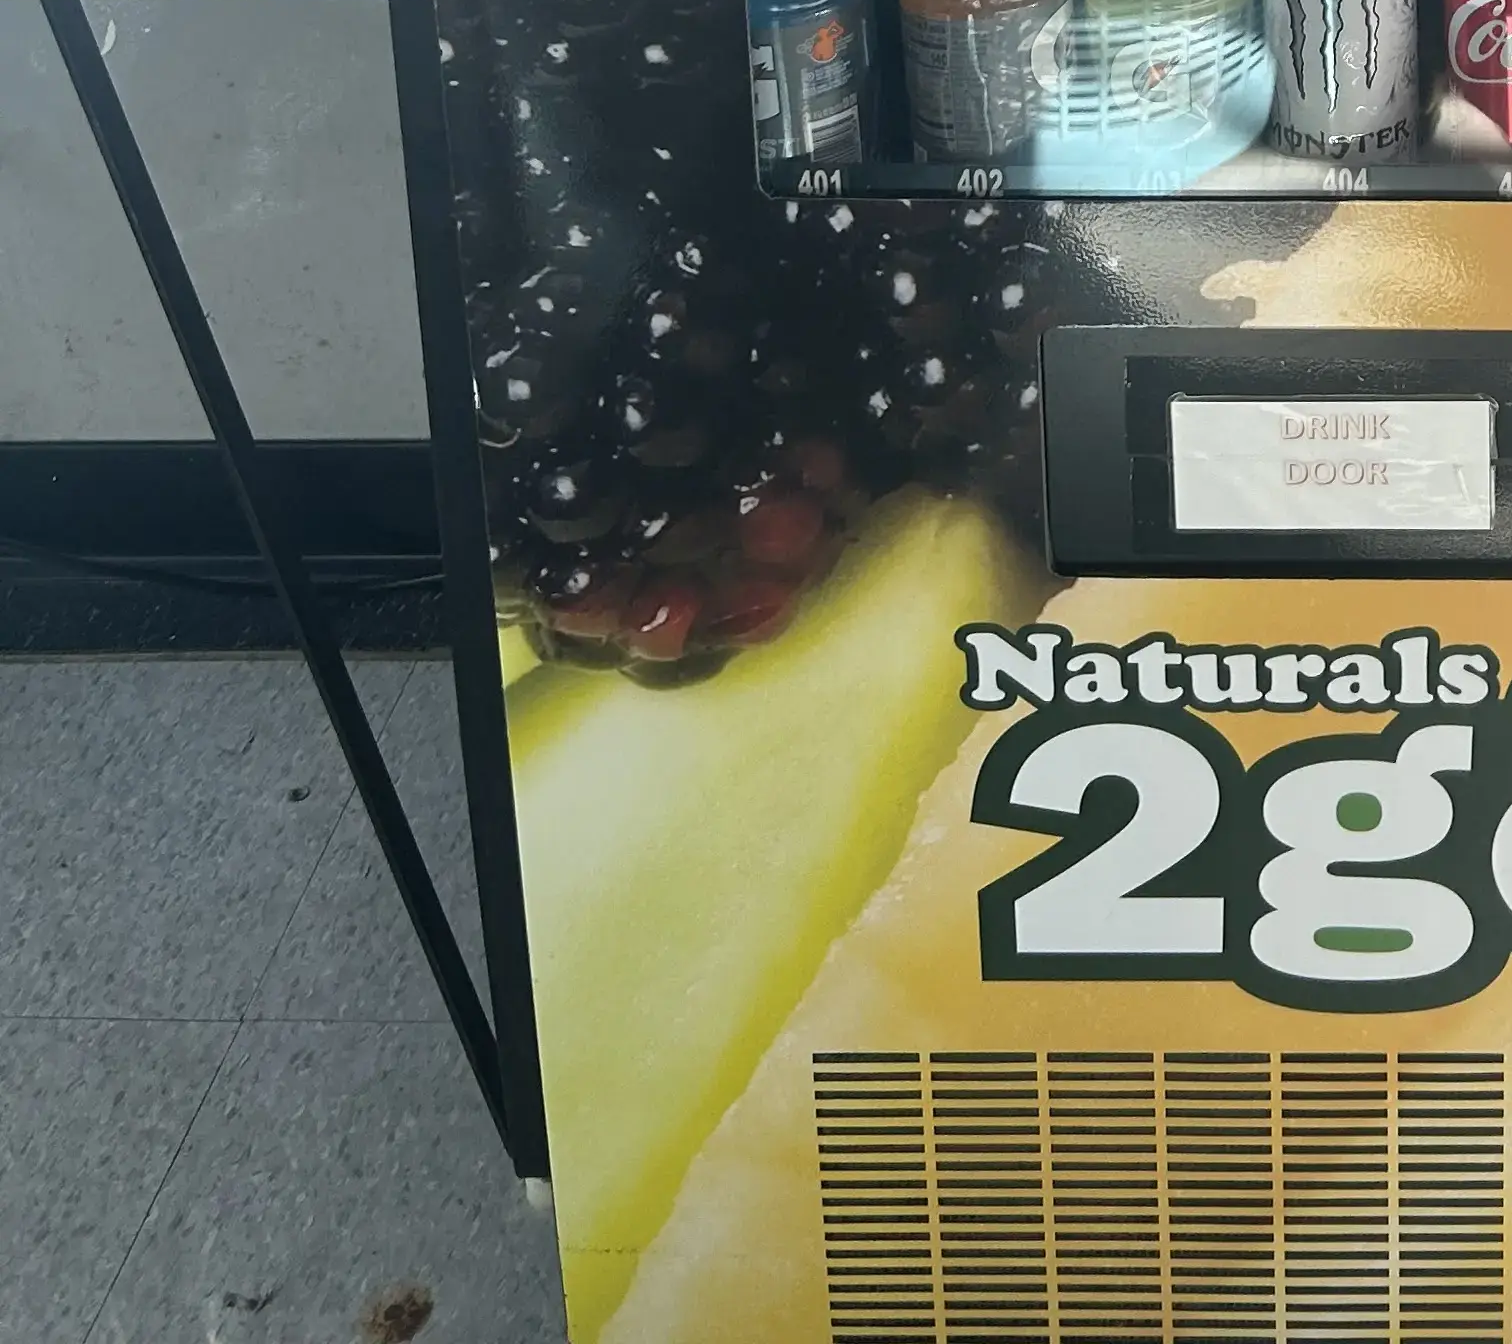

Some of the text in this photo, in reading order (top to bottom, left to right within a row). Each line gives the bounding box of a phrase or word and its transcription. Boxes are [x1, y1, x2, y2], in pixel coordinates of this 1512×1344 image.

[797, 168, 843, 196] 401
[956, 167, 1005, 198] 402
[1322, 167, 1370, 196] 404
[1280, 412, 1391, 442] DRINK
[1282, 460, 1390, 488] DOOR
[962, 630, 1490, 707] Naturals
